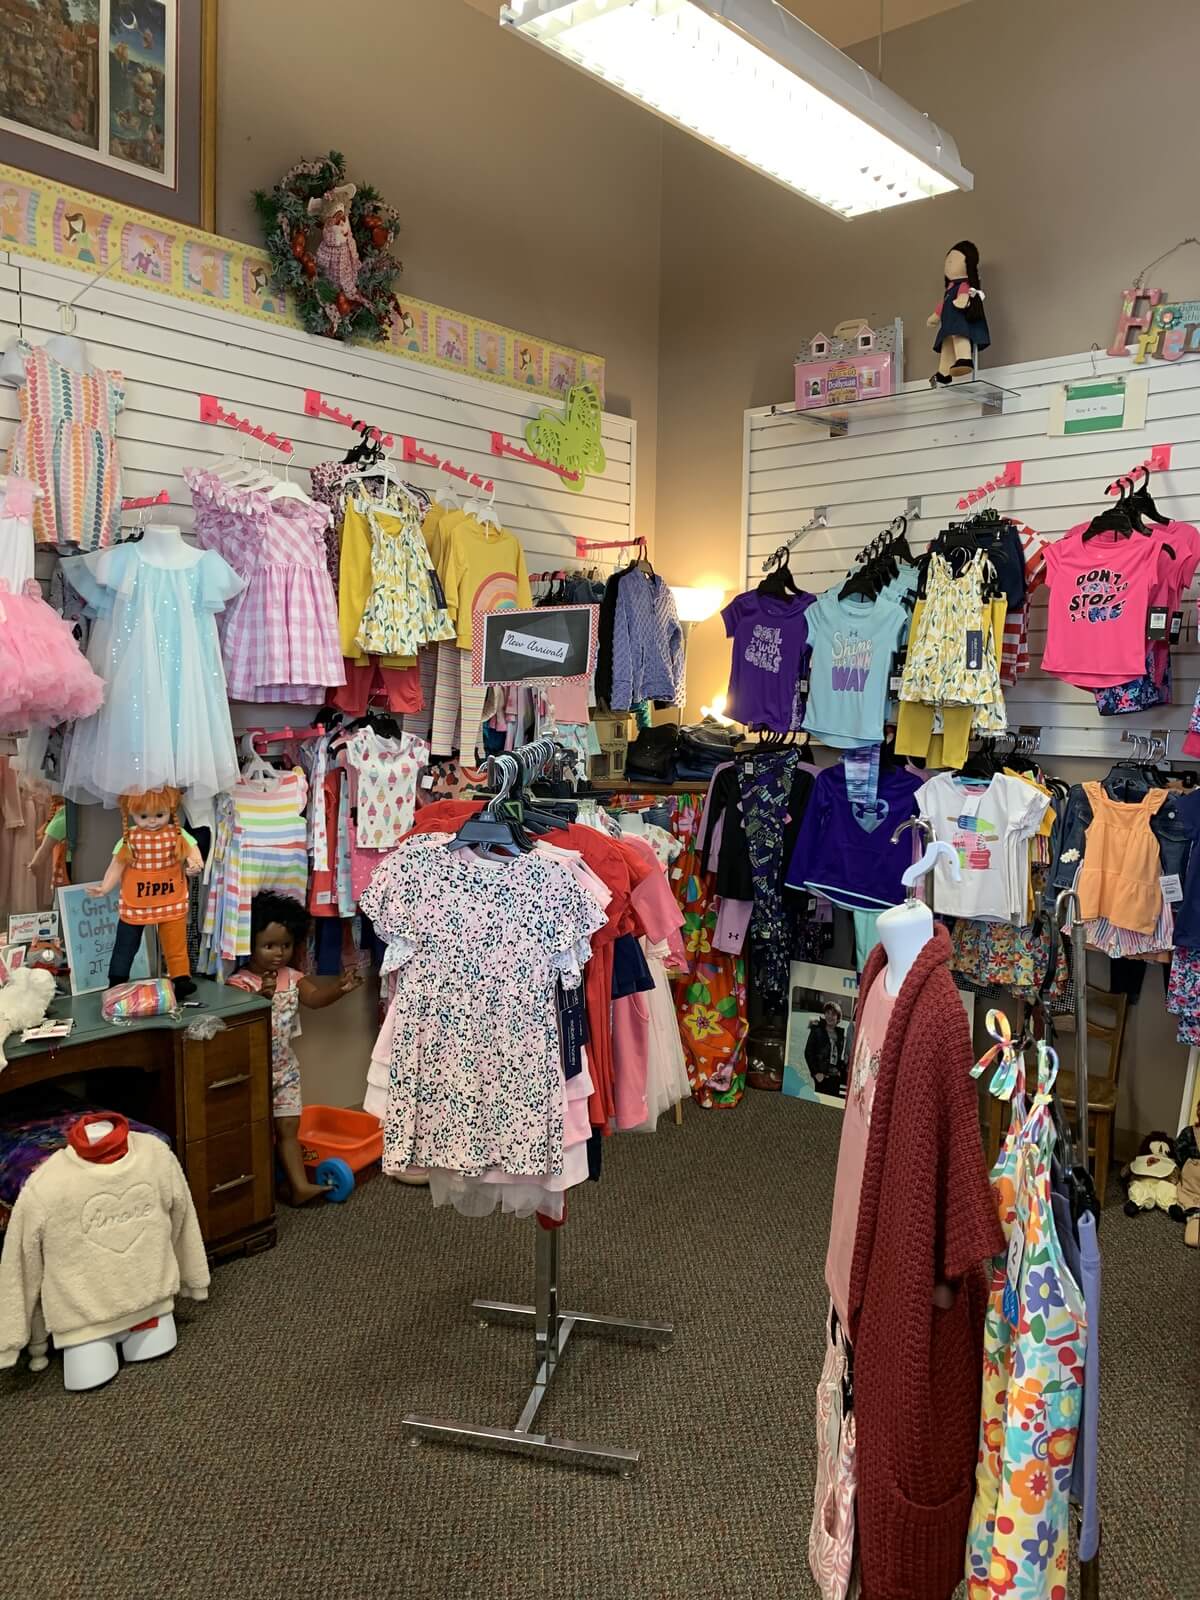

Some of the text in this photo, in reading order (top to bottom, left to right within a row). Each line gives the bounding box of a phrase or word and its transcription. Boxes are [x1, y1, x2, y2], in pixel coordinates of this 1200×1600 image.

[1076, 569, 1122, 586] DON'T
[1069, 593, 1116, 611] STOP
[504, 633, 564, 659] New Arrivals
[831, 666, 870, 692] WAY
